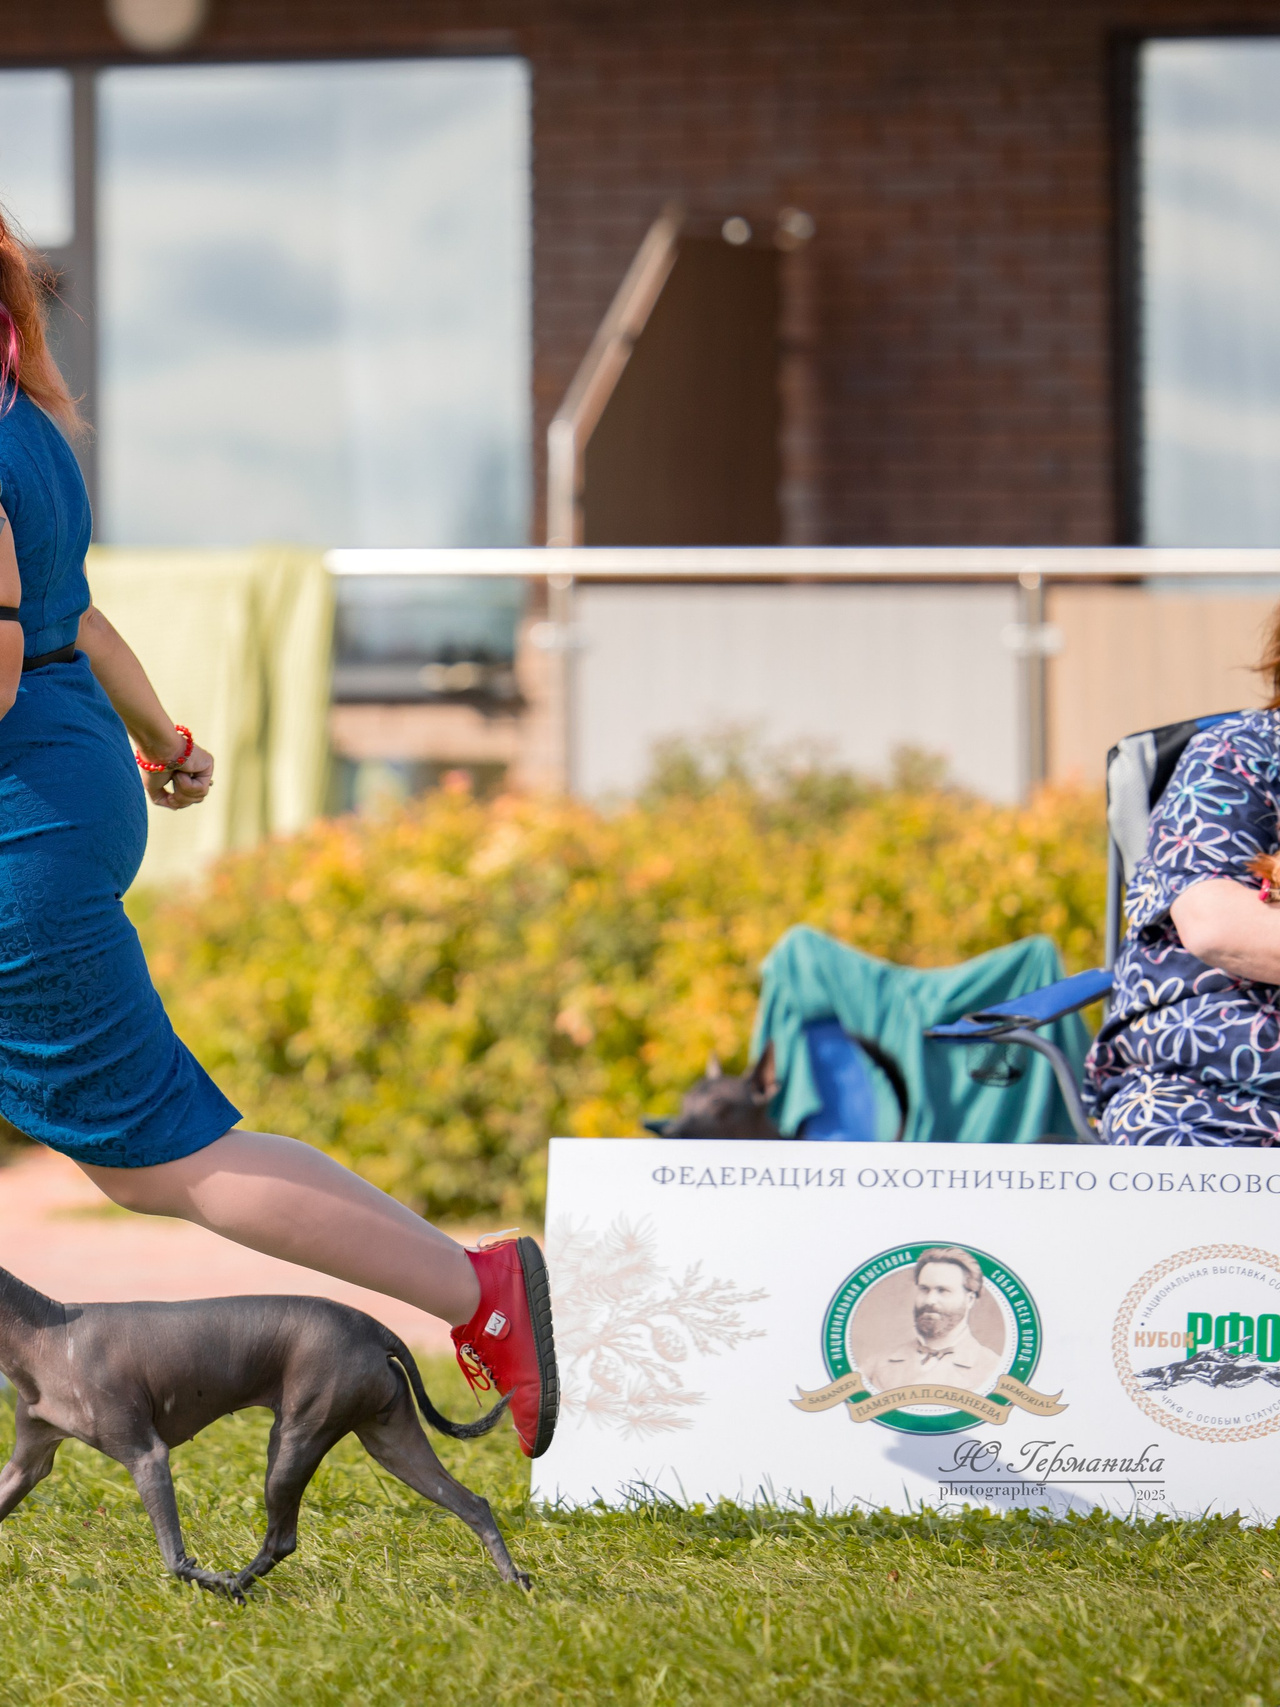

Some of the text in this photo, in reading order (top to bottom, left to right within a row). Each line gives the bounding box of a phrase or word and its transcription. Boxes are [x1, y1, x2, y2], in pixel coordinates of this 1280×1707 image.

[651, 1165, 847, 1190] ФЕДЕРАЦИЯ
[857, 1168, 1098, 1191] ОХОТНИЧЬЕГО
[1142, 1268, 1208, 1318] НАЦИОНАЛЬНАЯ
[1212, 1265, 1267, 1283] ВЫСТАВКА
[829, 1250, 1034, 1362] НАЦИОНАЛЬНАЯ ВЫСТАВКА СОБАК ВСЕХ ПОРОД
[1134, 1330, 1195, 1349] КУБОК
[807, 1379, 858, 1405] SABANEEV
[855, 1391, 906, 1417] ПАМЯТИ
[999, 1382, 1053, 1409] MEMORIAL
[1196, 1413, 1241, 1426] ОСОБЫМ
